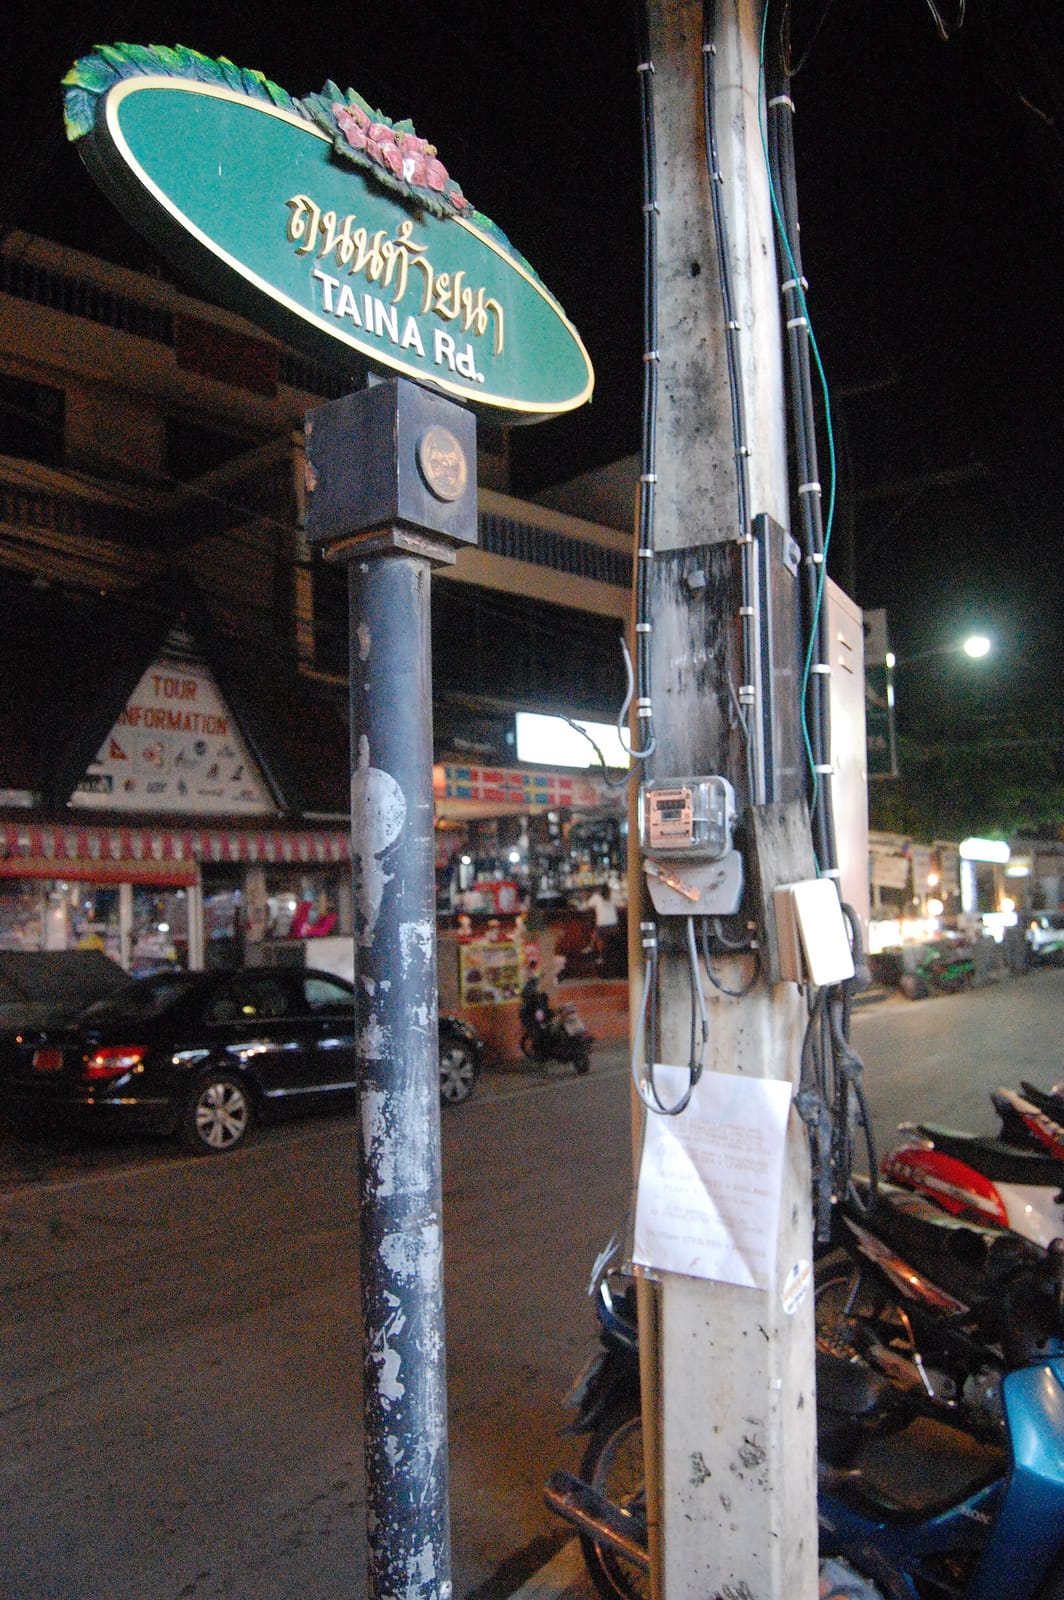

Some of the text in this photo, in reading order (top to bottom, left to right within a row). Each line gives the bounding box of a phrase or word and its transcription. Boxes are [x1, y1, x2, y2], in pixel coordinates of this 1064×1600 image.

[285, 194, 504, 356] ถนนท้ายนา
[312, 269, 485, 383] TAINA Rd.
[152, 674, 198, 701] TOUR
